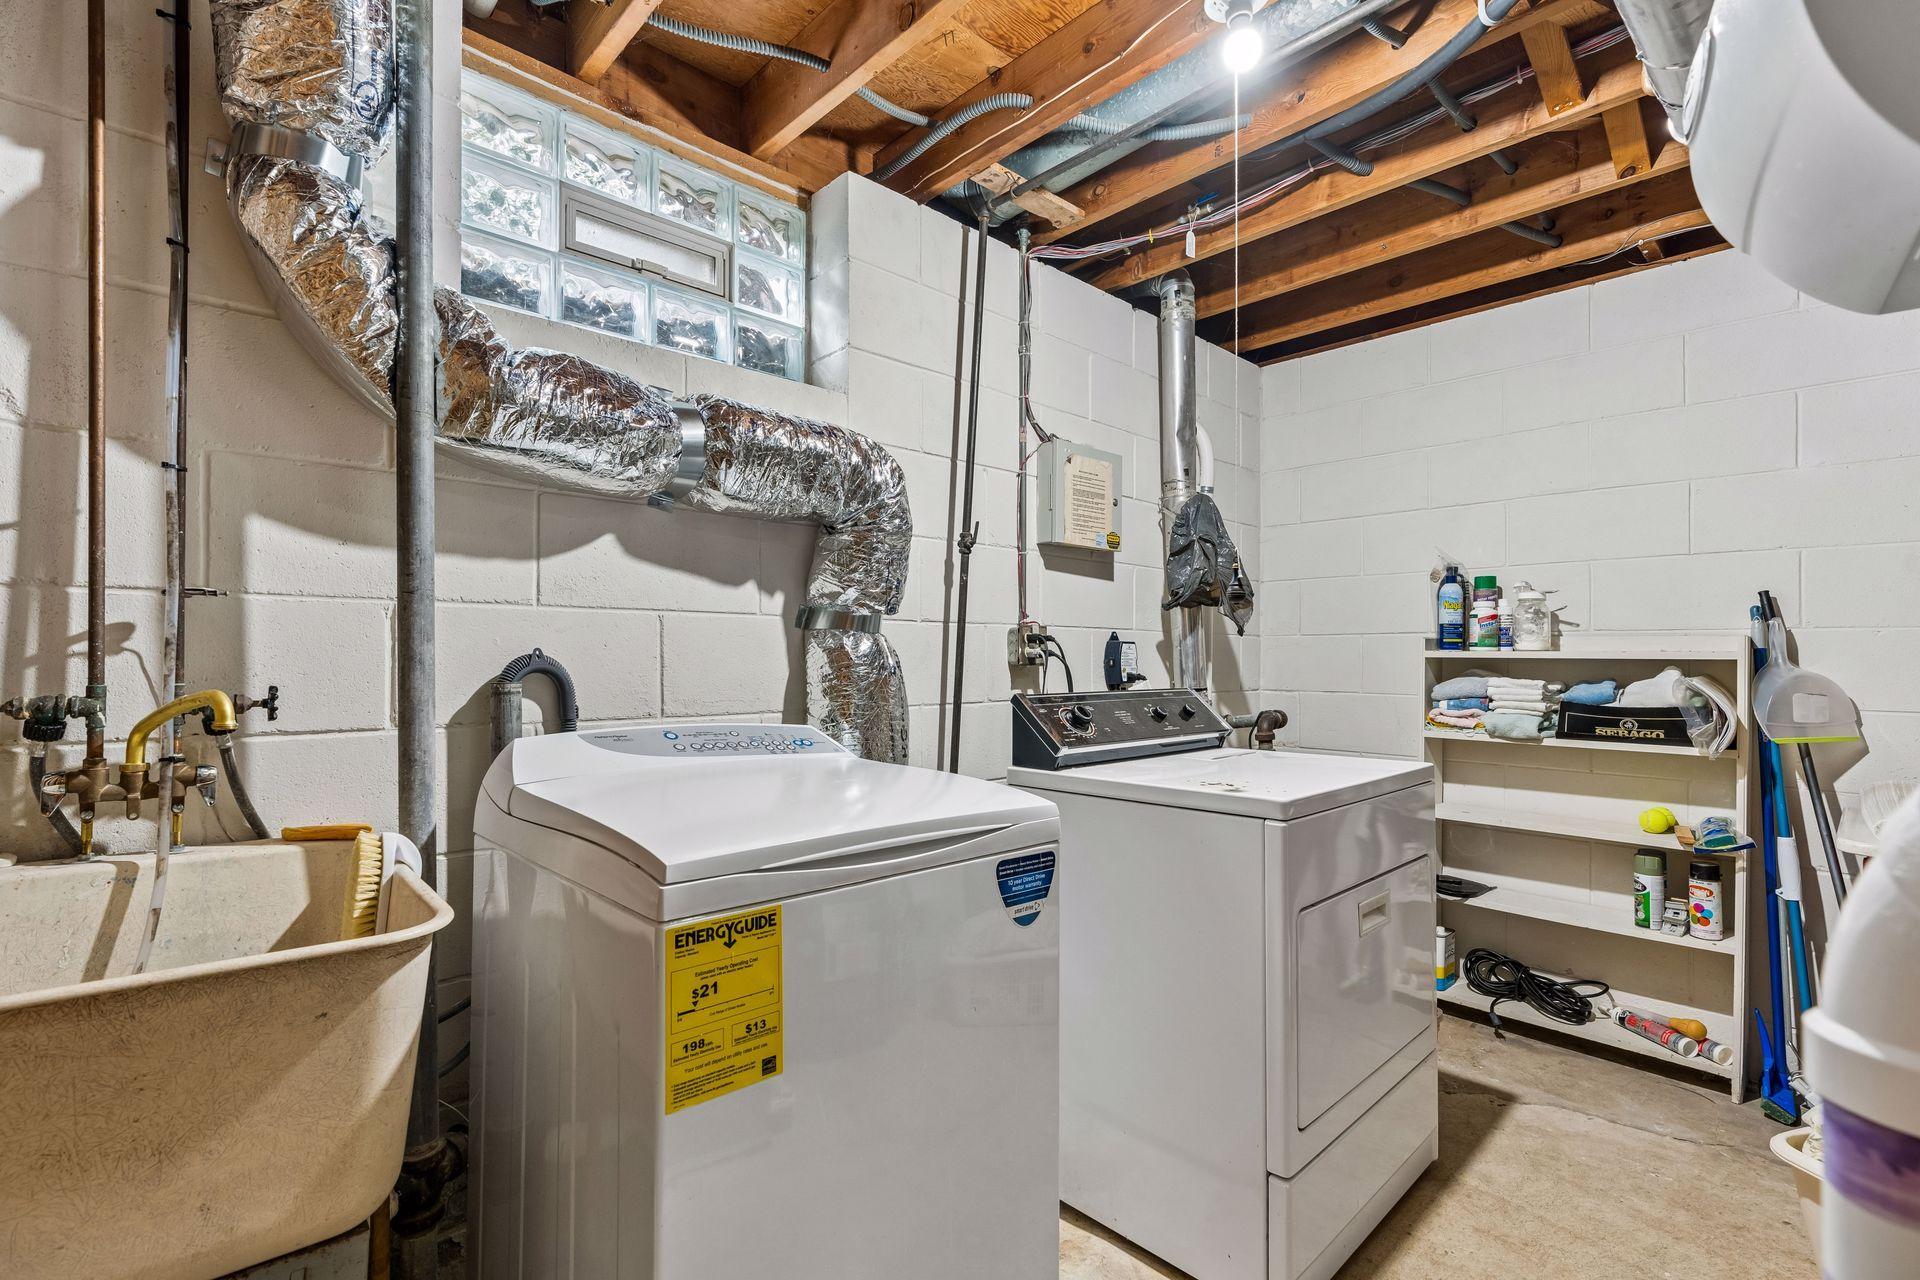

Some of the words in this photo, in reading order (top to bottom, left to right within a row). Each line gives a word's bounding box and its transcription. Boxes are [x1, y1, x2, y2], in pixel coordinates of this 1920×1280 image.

[1595, 728, 1665, 739] SEBAGO
[1023, 875, 1035, 883] Direct
[1025, 881, 1042, 889] warranty
[674, 912, 777, 949] ENERGYGUIDE
[691, 981, 719, 1000] $21
[745, 1019, 767, 1034] $13
[682, 1038, 706, 1054] 198
